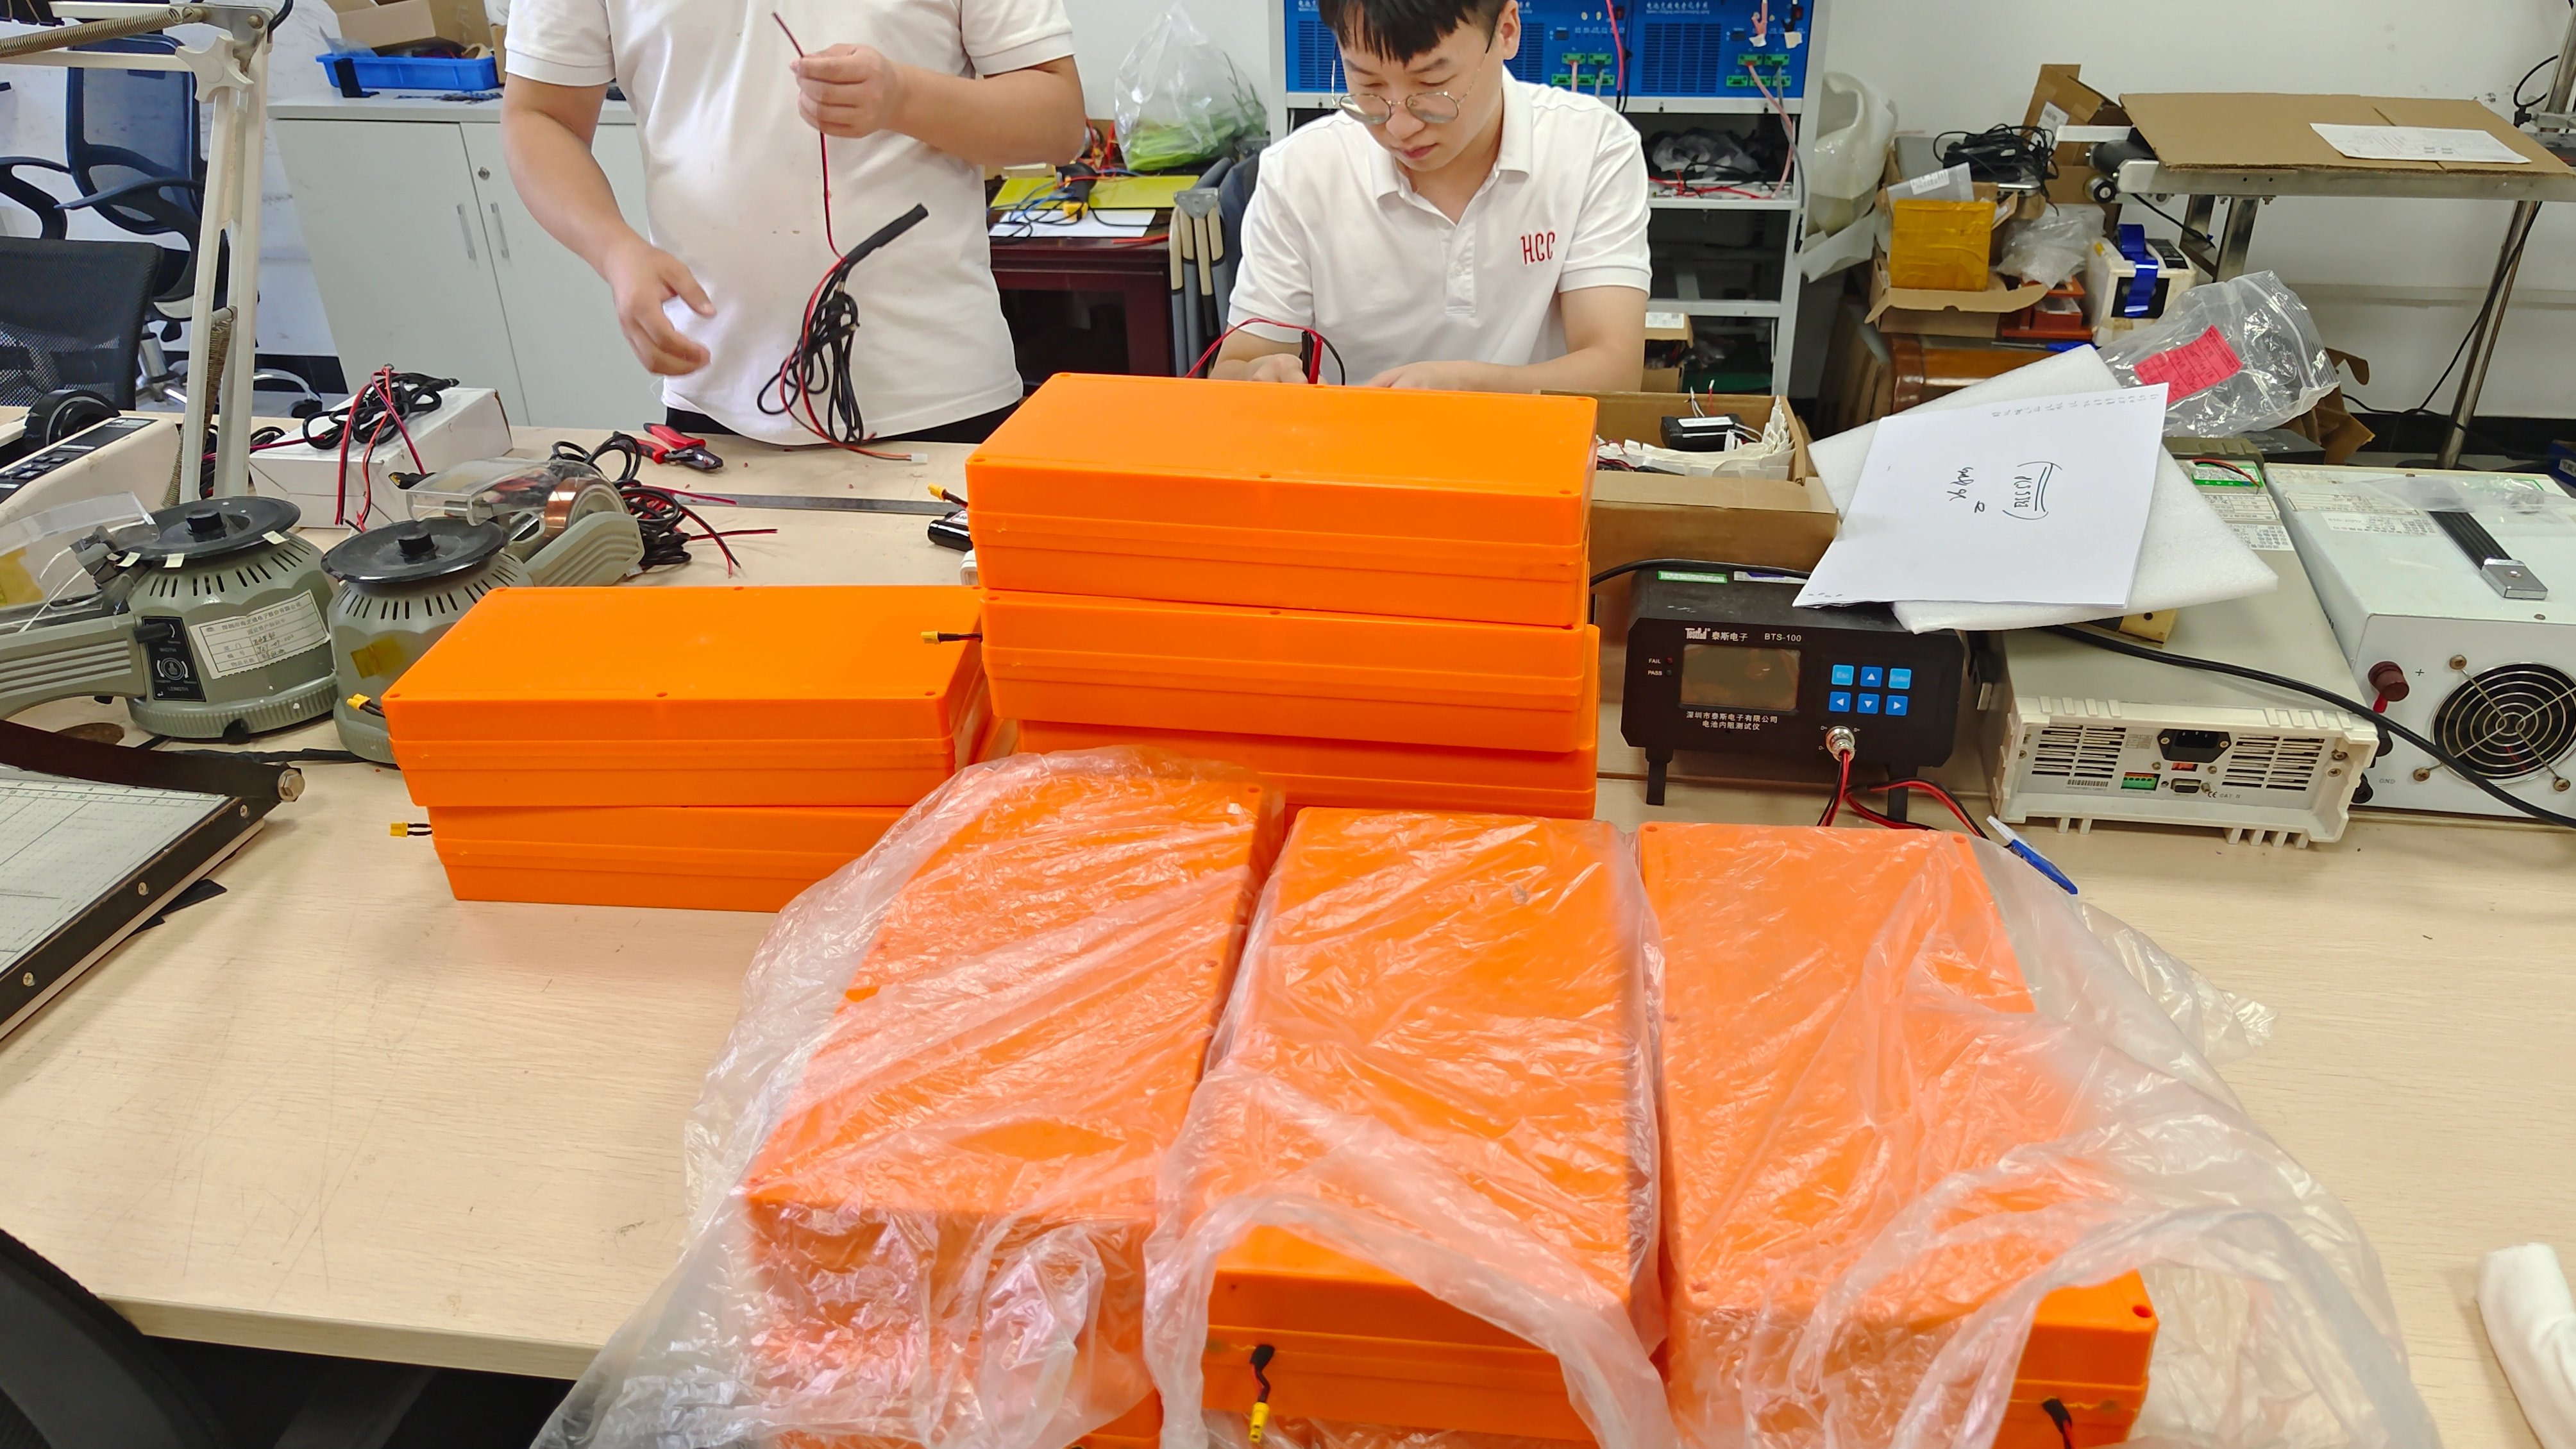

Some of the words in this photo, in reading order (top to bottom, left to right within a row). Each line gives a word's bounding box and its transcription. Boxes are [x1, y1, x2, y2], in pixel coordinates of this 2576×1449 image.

[1520, 232, 1555, 265] HCC
[1712, 632, 1748, 642] 泰斯电子
[1764, 632, 1802, 642] BTS-100
[1686, 711, 1778, 724] 深圳市泰斯电子有限公司
[1702, 720, 1760, 731] 电池内阻测试仪
